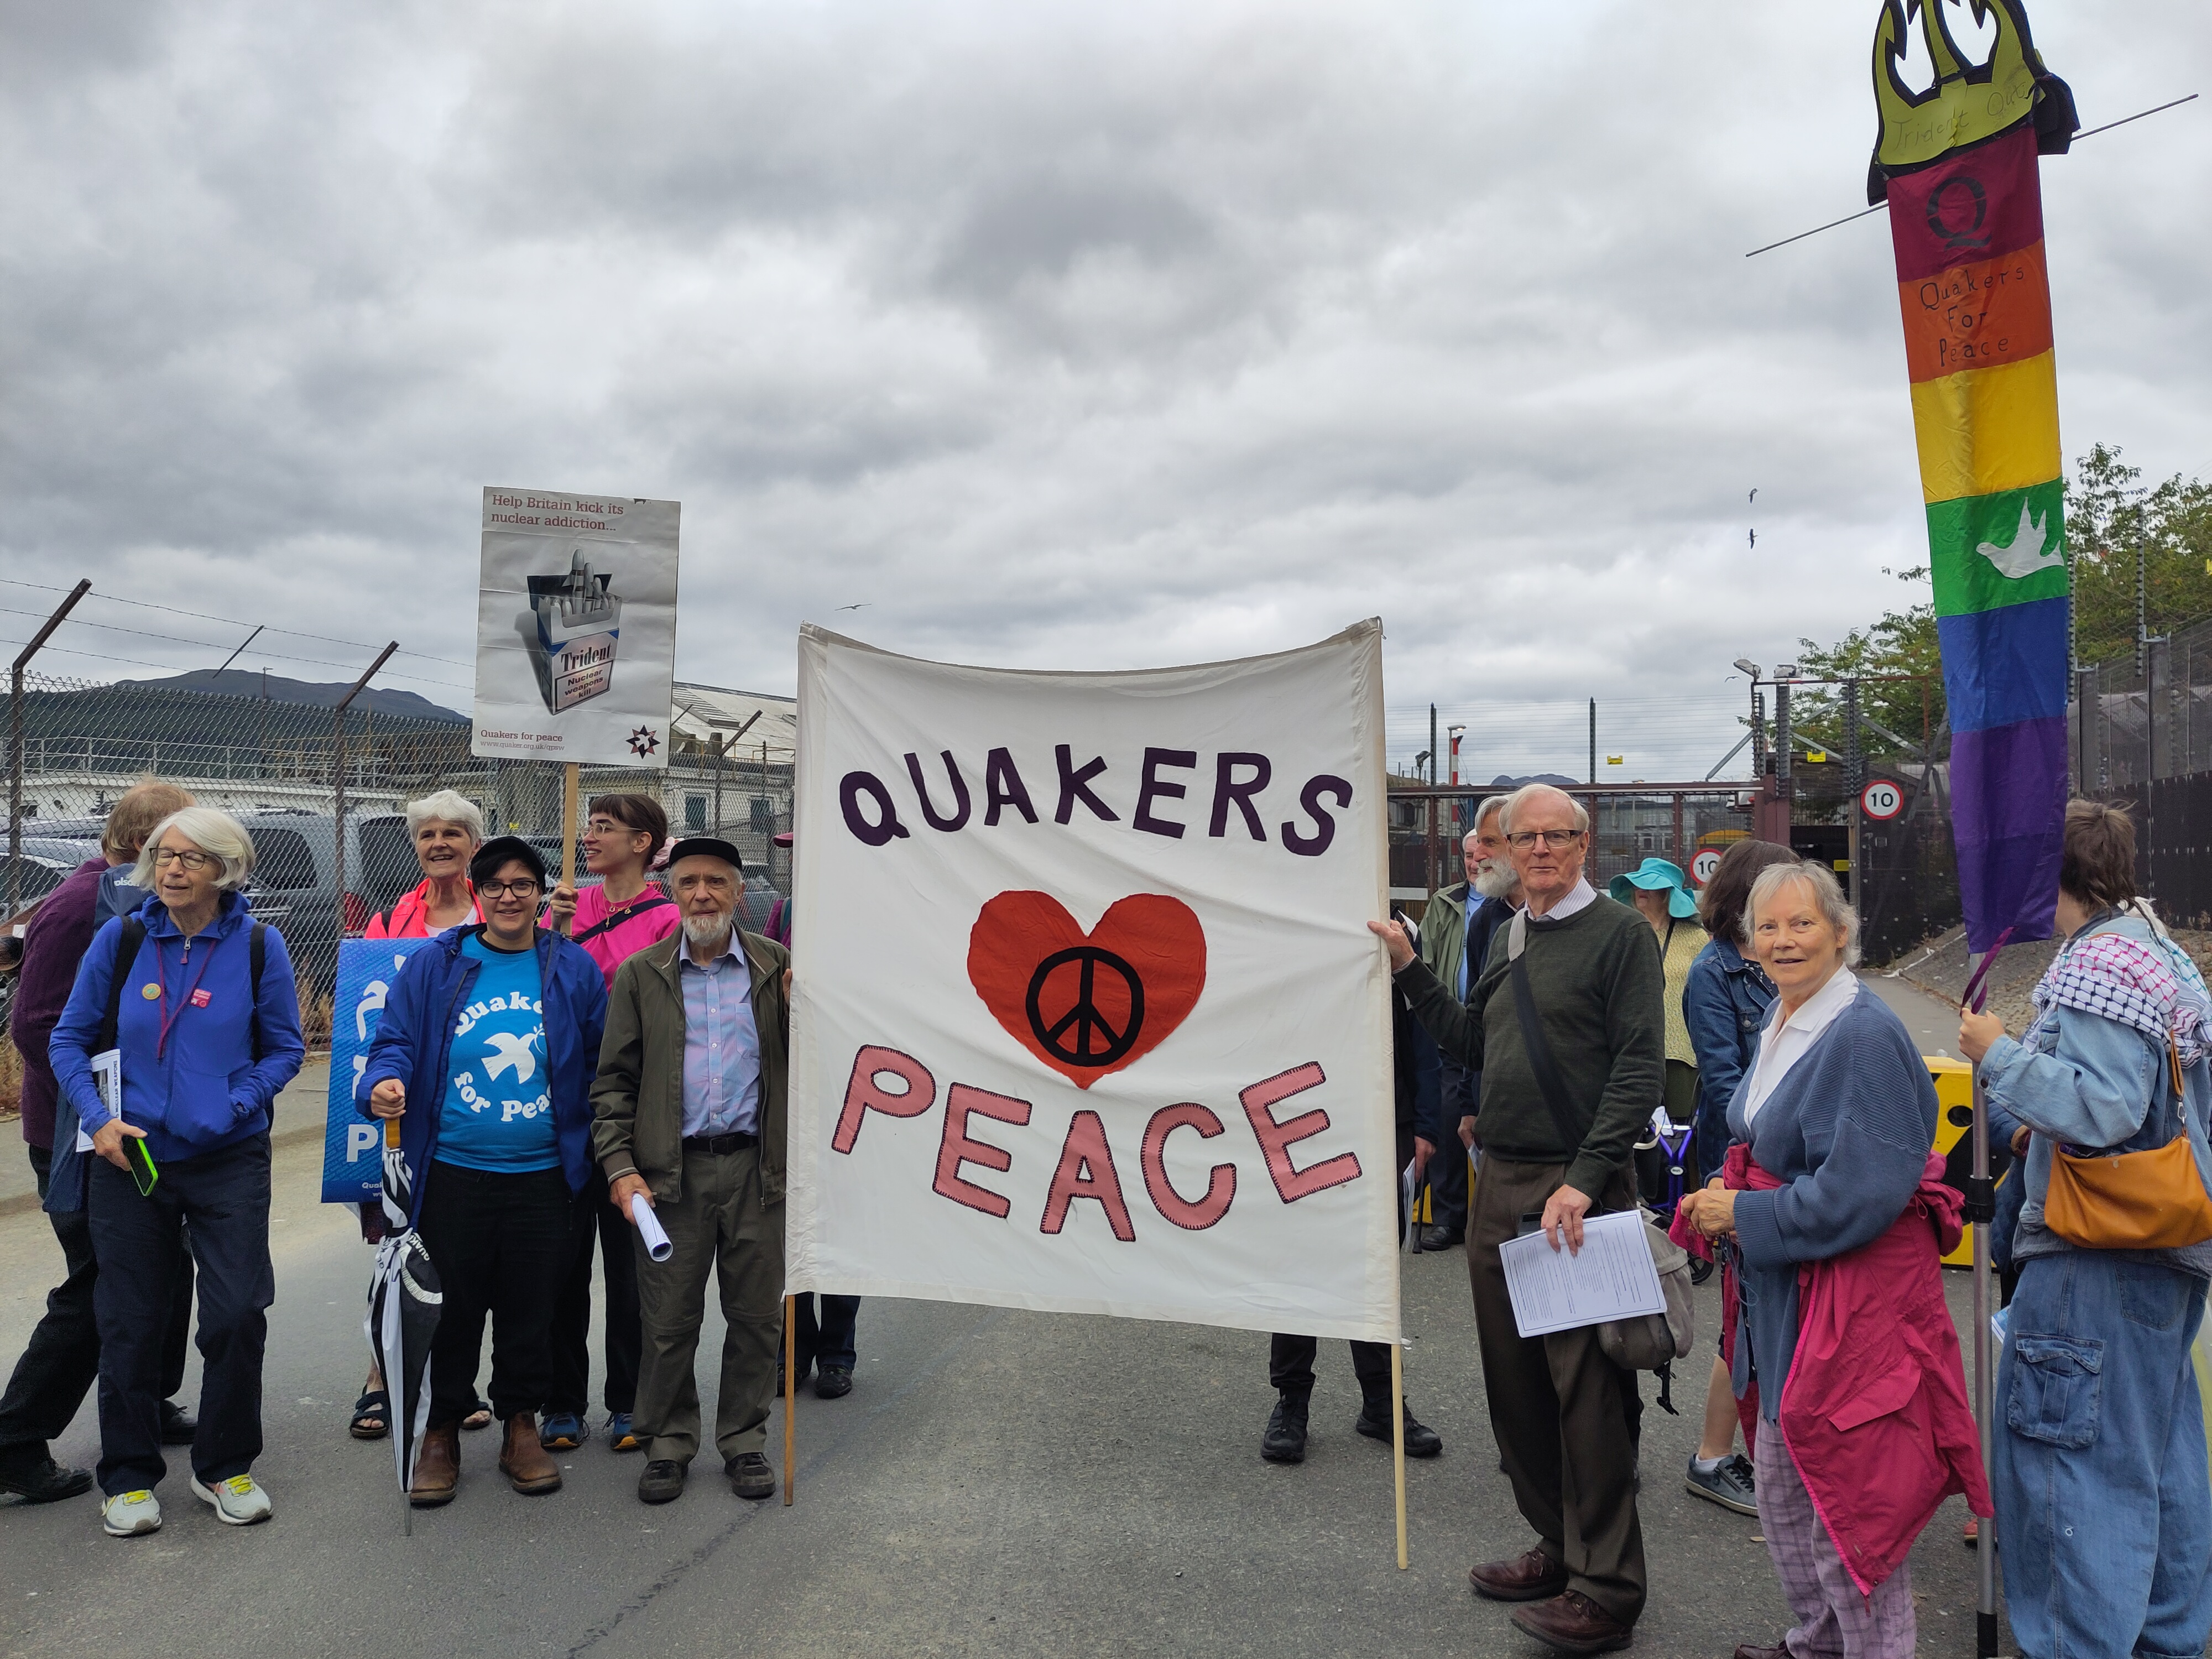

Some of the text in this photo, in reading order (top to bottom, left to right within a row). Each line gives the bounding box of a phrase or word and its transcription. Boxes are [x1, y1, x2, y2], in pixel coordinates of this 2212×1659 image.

[1926, 176, 1992, 249] Q
[1921, 267, 2024, 310] Quakers
[1947, 305, 1988, 332] For
[1939, 338, 2008, 367] Peace
[492, 494, 624, 515] Help Britain kick its
[491, 512, 617, 531] nuclear addiction...
[560, 642, 612, 673] Trident
[564, 677, 604, 696] weapons
[567, 669, 603, 687] Nuclear
[578, 688, 592, 698] kill
[480, 729, 519, 739] Quakers
[521, 732, 534, 740] for
[839, 744, 1353, 857] QUAKERS
[1871, 792, 1894, 807] 10
[831, 1044, 1363, 1243] PEACE
